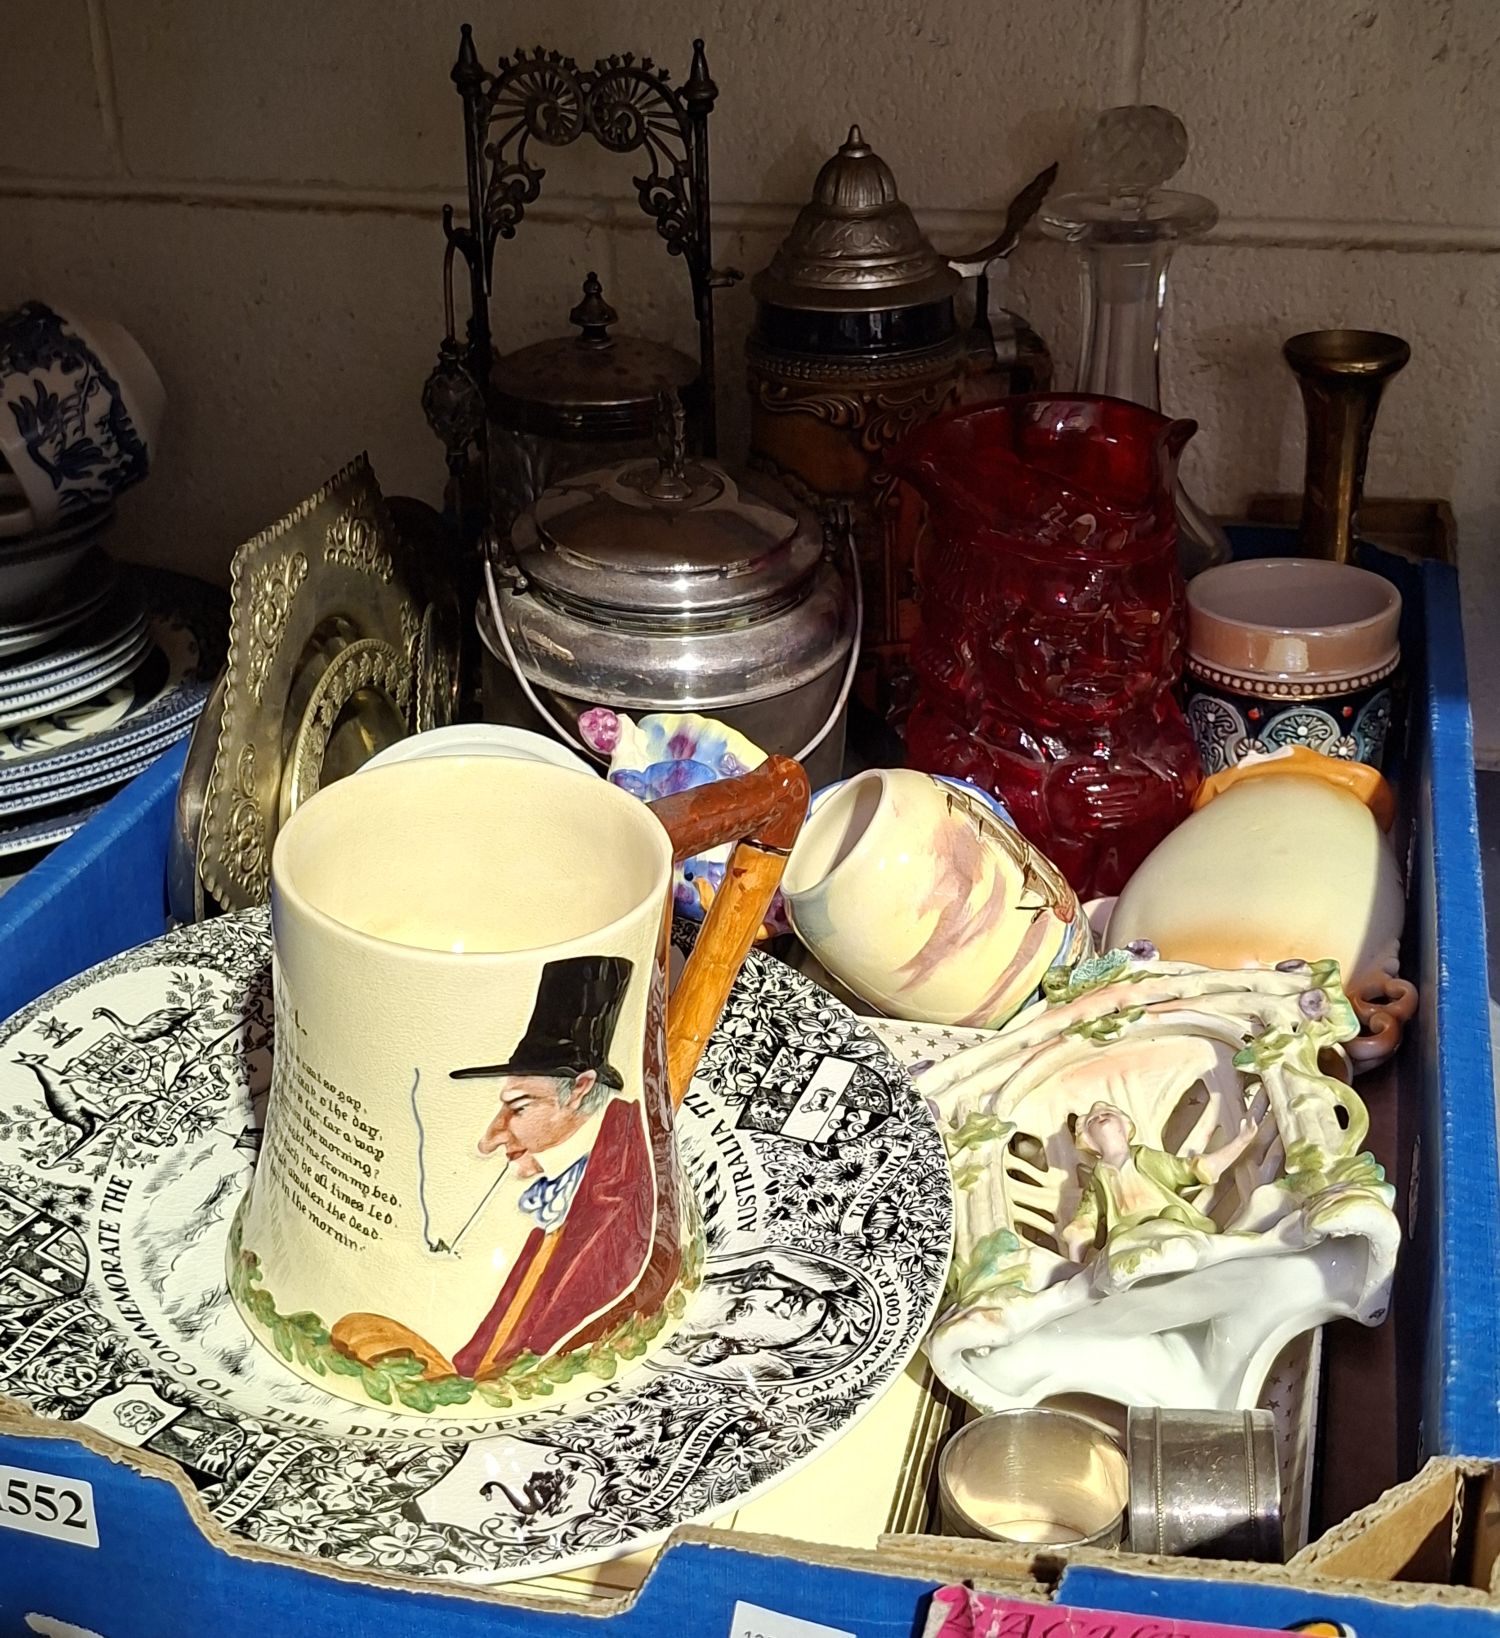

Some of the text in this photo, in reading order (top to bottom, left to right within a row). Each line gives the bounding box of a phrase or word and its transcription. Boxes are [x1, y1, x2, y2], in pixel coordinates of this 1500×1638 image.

[156, 1082, 222, 1140] AUSTRALIA
[710, 1118, 758, 1233] AUSTRALIA
[848, 1155, 908, 1220] TASMANIA
[98, 1174, 236, 1400] TO COMMEMORATE THE
[5, 1302, 86, 1365] SOUTH WALES
[853, 1329, 897, 1375] JAMES
[883, 1288, 902, 1326] COOK
[264, 1380, 622, 1440] THE DISCOVERY OF
[213, 1440, 306, 1523] UEENSLAND
[640, 1412, 739, 1509] WESTERN AUSTRALIA
[0, 1479, 88, 1529] 552
